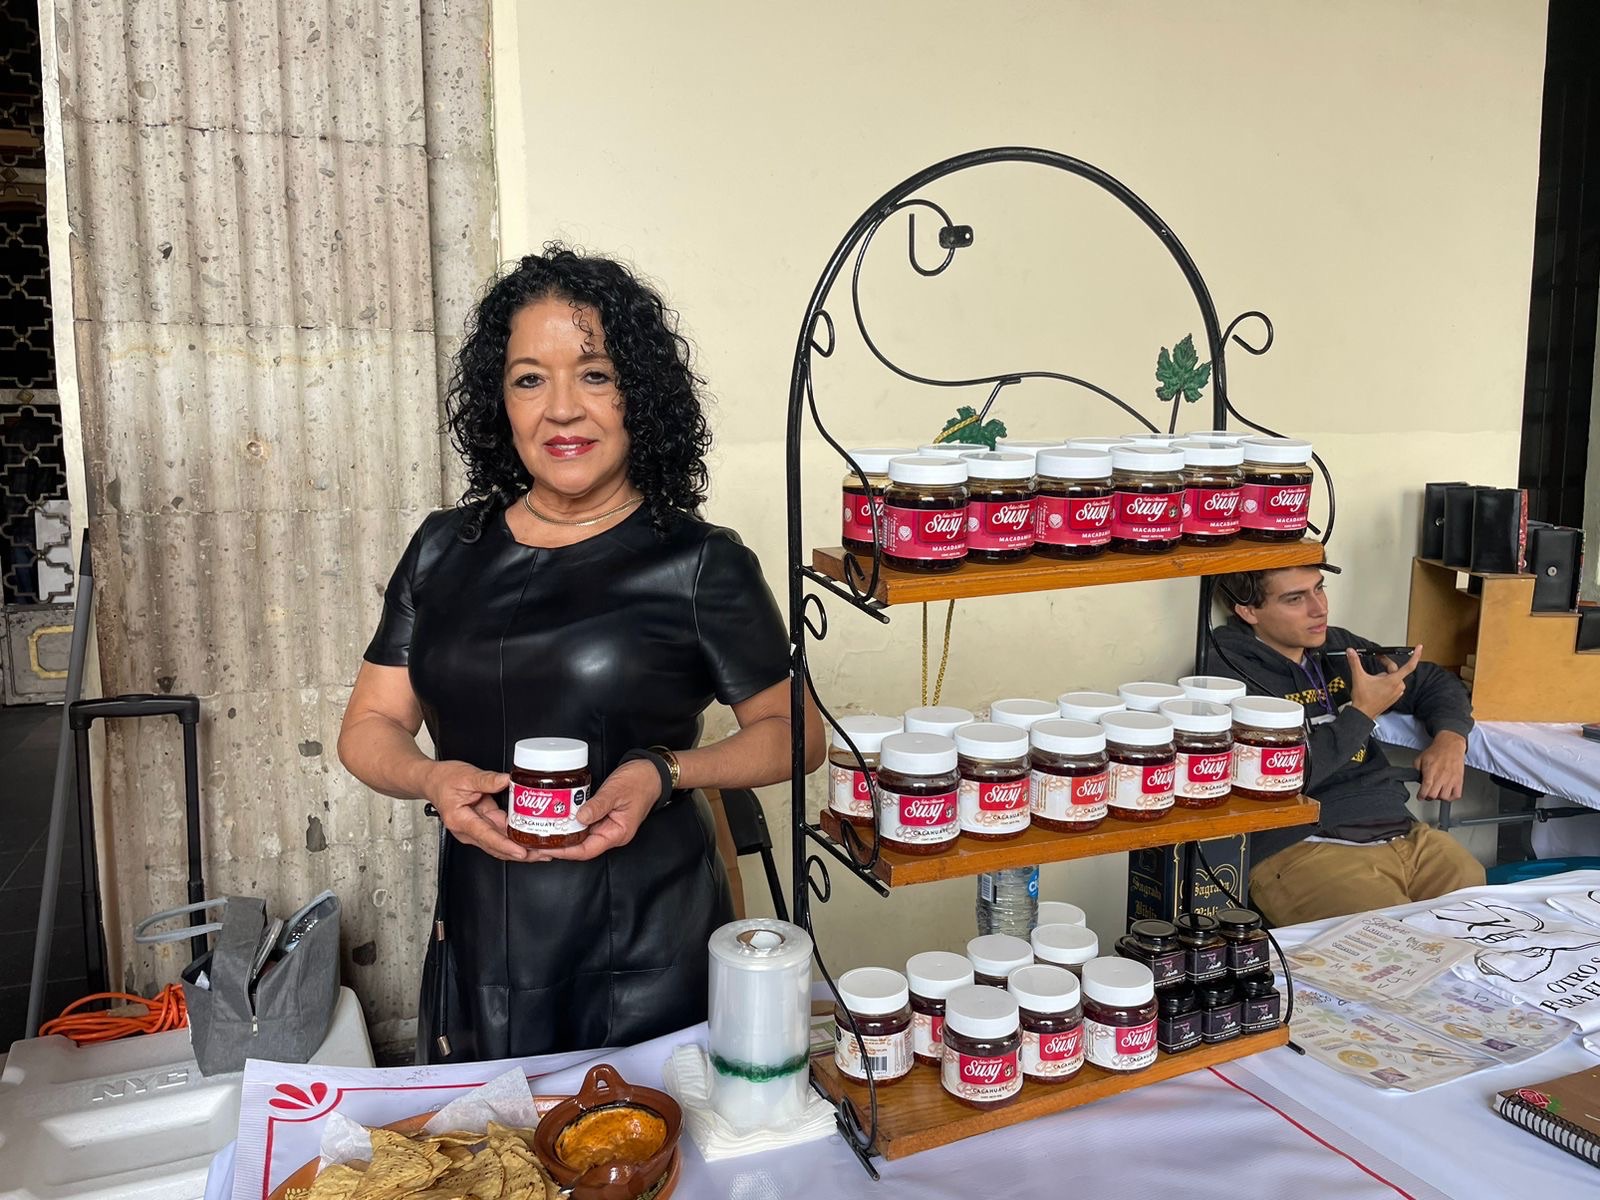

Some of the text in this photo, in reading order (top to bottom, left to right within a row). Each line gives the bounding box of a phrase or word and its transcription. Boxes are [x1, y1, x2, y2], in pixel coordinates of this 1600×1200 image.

[1126, 497, 1168, 522] Susy
[1204, 493, 1239, 517] Susy
[1270, 490, 1306, 513] Susy
[992, 506, 1030, 530] Susy
[1076, 502, 1110, 527] Susy
[925, 514, 963, 539] Susy
[1193, 758, 1228, 780] Susy
[1266, 751, 1300, 774] Susy
[1076, 779, 1107, 801] Susy
[1147, 769, 1175, 791] Susy
[516, 790, 553, 815] Susy
[985, 785, 1022, 809] Susy
[904, 800, 945, 824] Susy
[1045, 1037, 1078, 1057] Susy
[1121, 1030, 1153, 1051] Susy
[964, 1060, 1003, 1083] Susy
